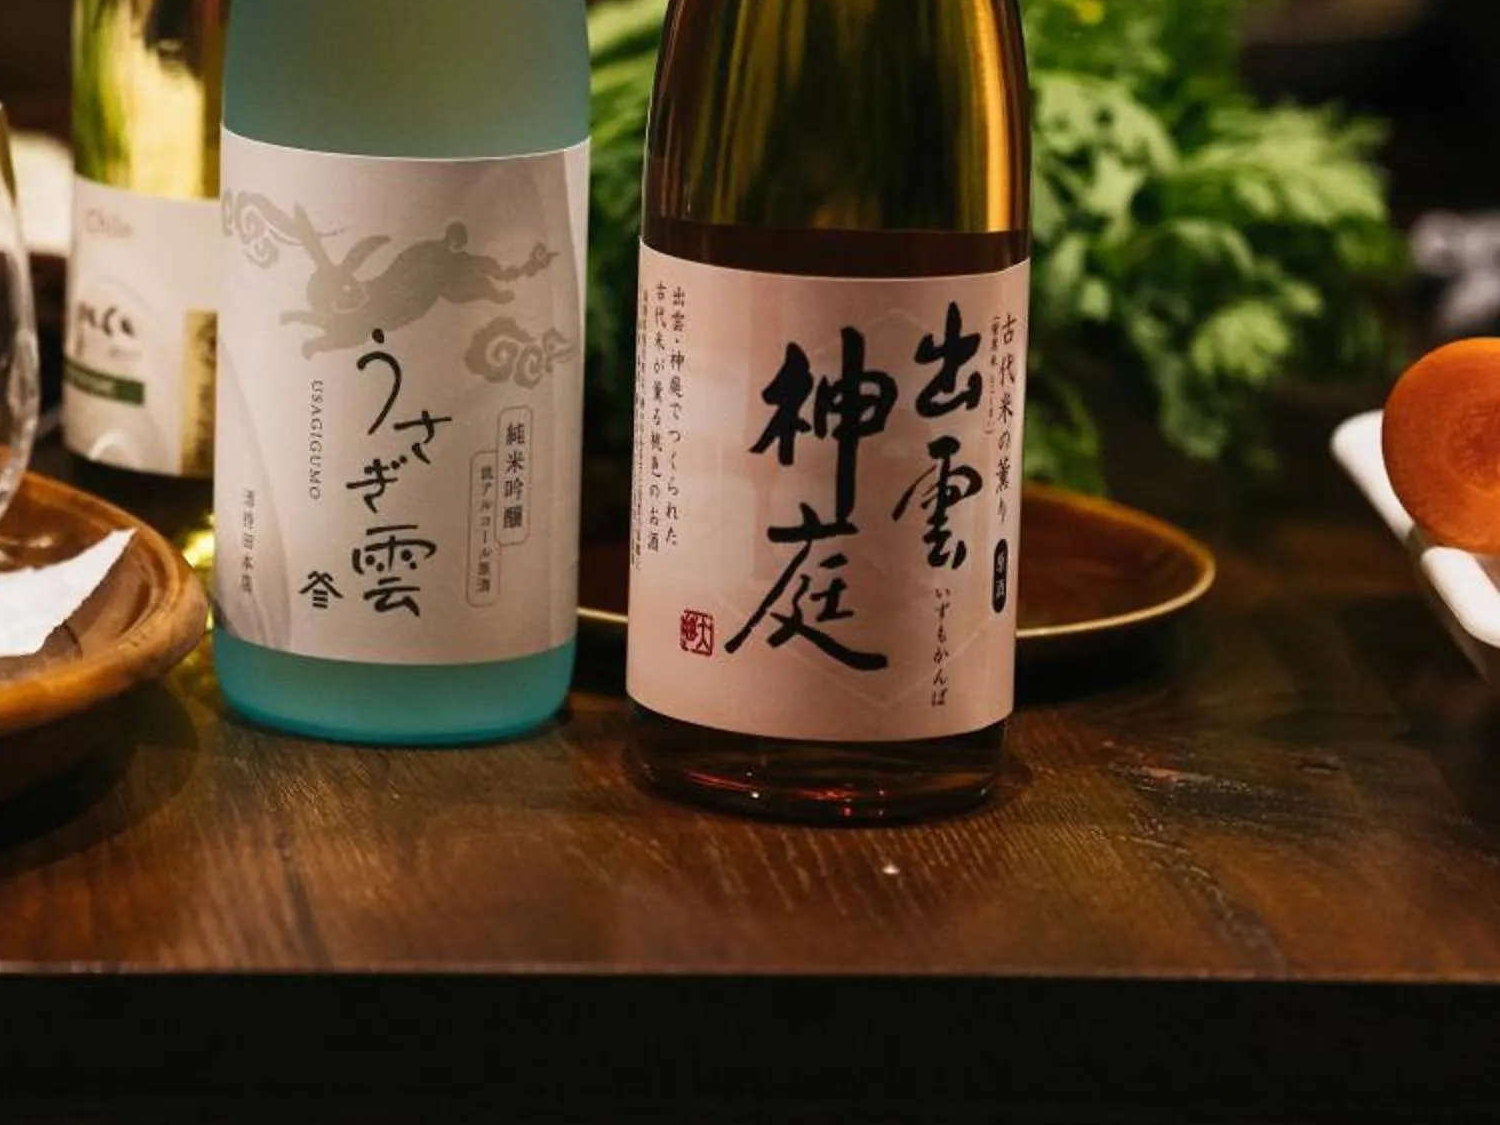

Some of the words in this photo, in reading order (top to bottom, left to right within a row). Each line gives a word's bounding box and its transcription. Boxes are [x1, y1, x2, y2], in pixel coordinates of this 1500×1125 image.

[308, 379, 325, 501] USAGIGUMO
[346, 328, 453, 618] うさぎ雲
[502, 420, 526, 529] 純米吟醸
[724, 326, 899, 672] 神庭
[891, 301, 984, 571] 出雲
[931, 587, 952, 708] いずもかんば
